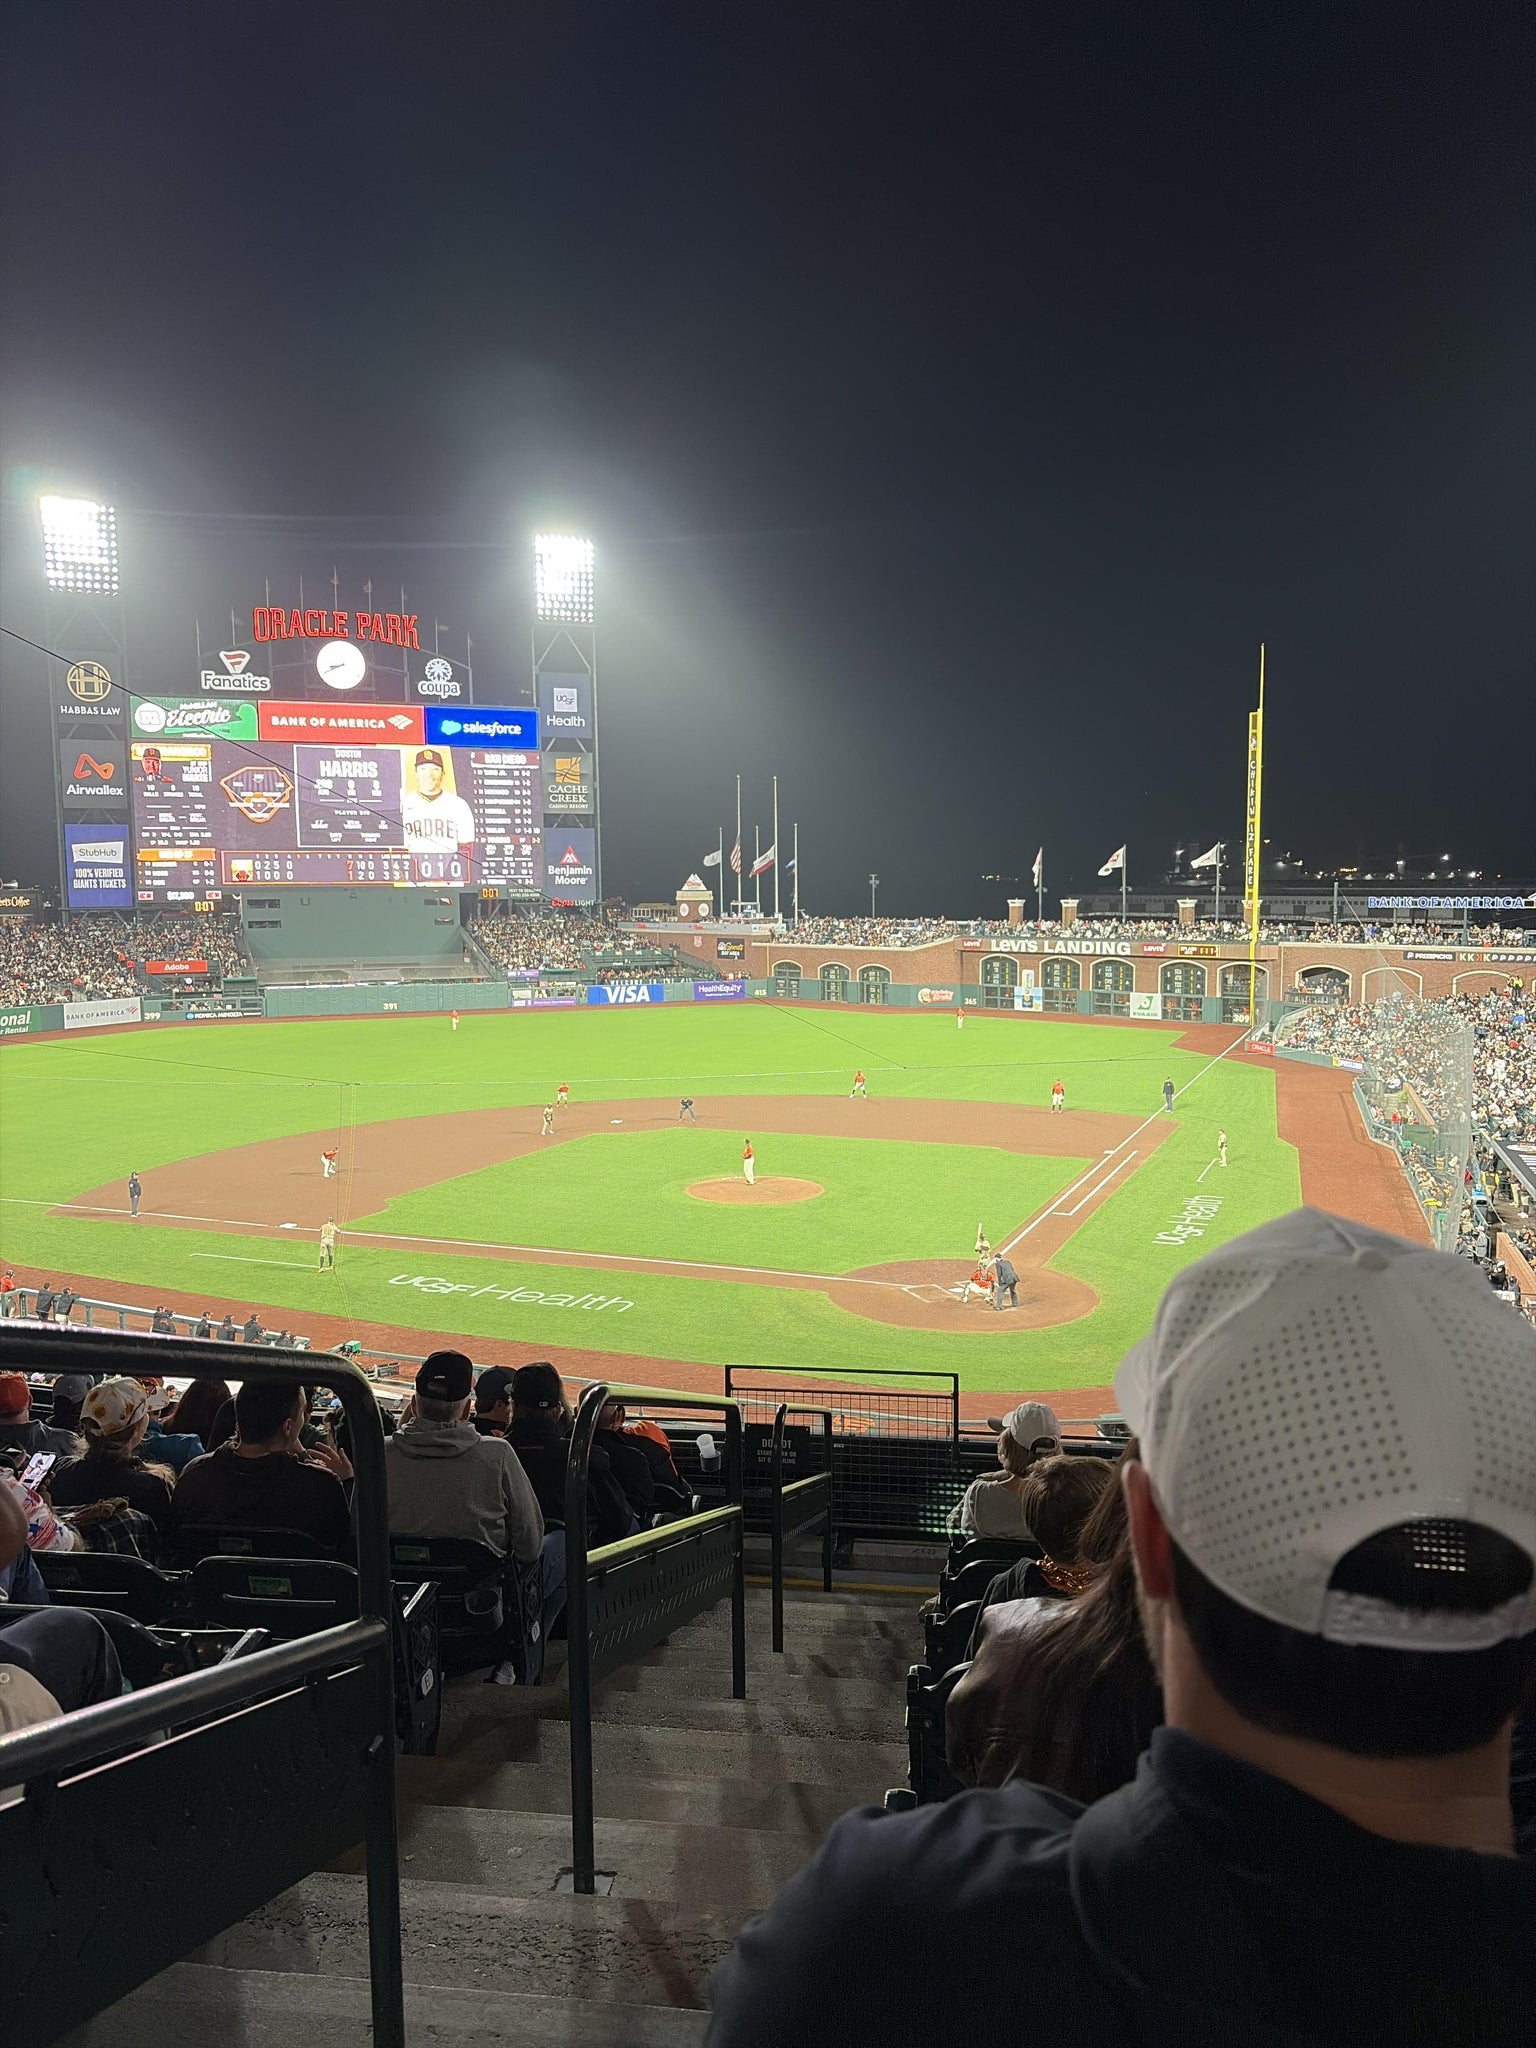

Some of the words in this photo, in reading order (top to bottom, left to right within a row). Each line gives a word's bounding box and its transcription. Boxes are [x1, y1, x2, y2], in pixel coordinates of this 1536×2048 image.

[253, 607, 348, 642] ORACLE
[355, 612, 420, 650] PARK
[203, 674, 269, 690] Fanatics
[420, 684, 460, 698] coupa
[60, 705, 99, 715] HABBAS
[100, 706, 121, 716] LAW
[166, 707, 231, 727] Electric
[271, 716, 307, 727] BANK
[308, 716, 326, 728] OF
[328, 717, 386, 729] AMERICA
[546, 715, 586, 727] Health
[462, 720, 522, 737] salesforce
[320, 760, 379, 778] HARRIS
[66, 784, 124, 797] Airwallex
[548, 785, 588, 794] CACHE
[549, 794, 587, 803] CREEK
[78, 848, 117, 857] StubHub
[255, 861, 261, 870] 0
[264, 861, 271, 870] 2
[274, 861, 280, 870] 5
[286, 861, 293, 870] 0
[346, 861, 354, 870] 7
[357, 861, 366, 870] 10
[403, 861, 410, 870] 2
[421, 861, 432, 878] 0
[437, 861, 444, 878] 1
[450, 861, 462, 878] 0
[74, 868, 94, 878] 100%
[94, 868, 124, 878] VERIFIED
[256, 871, 261, 880] 1
[264, 871, 271, 880] 0
[274, 871, 280, 880] 0
[286, 871, 294, 880] 0
[347, 871, 354, 880] 1
[358, 871, 365, 880] 2
[547, 866, 593, 877] Benjamin
[73, 879, 98, 889] GIANTS
[99, 879, 127, 889] TICKETS
[554, 876, 587, 885] Moore
[482, 888, 499, 898] 0:07
[11, 896, 31, 907] Coffee
[194, 901, 214, 912] 0:07
[1368, 896, 1414, 909] BANK
[1416, 896, 1440, 909] OF
[1442, 896, 1525, 909] AMERICA
[1043, 940, 1131, 955] LANDING
[164, 963, 190, 971] Adobe
[602, 985, 650, 1003] VISA
[698, 985, 742, 995] HealthEquity
[144, 1012, 160, 1020] 399
[1233, 1014, 1249, 1023] 309
[5, 1026, 28, 1034] Rental
[1167, 1195, 1224, 1226] Health
[388, 1274, 476, 1294] UCSF
[469, 1284, 635, 1313] Health
[761, 1439, 773, 1448] DO
